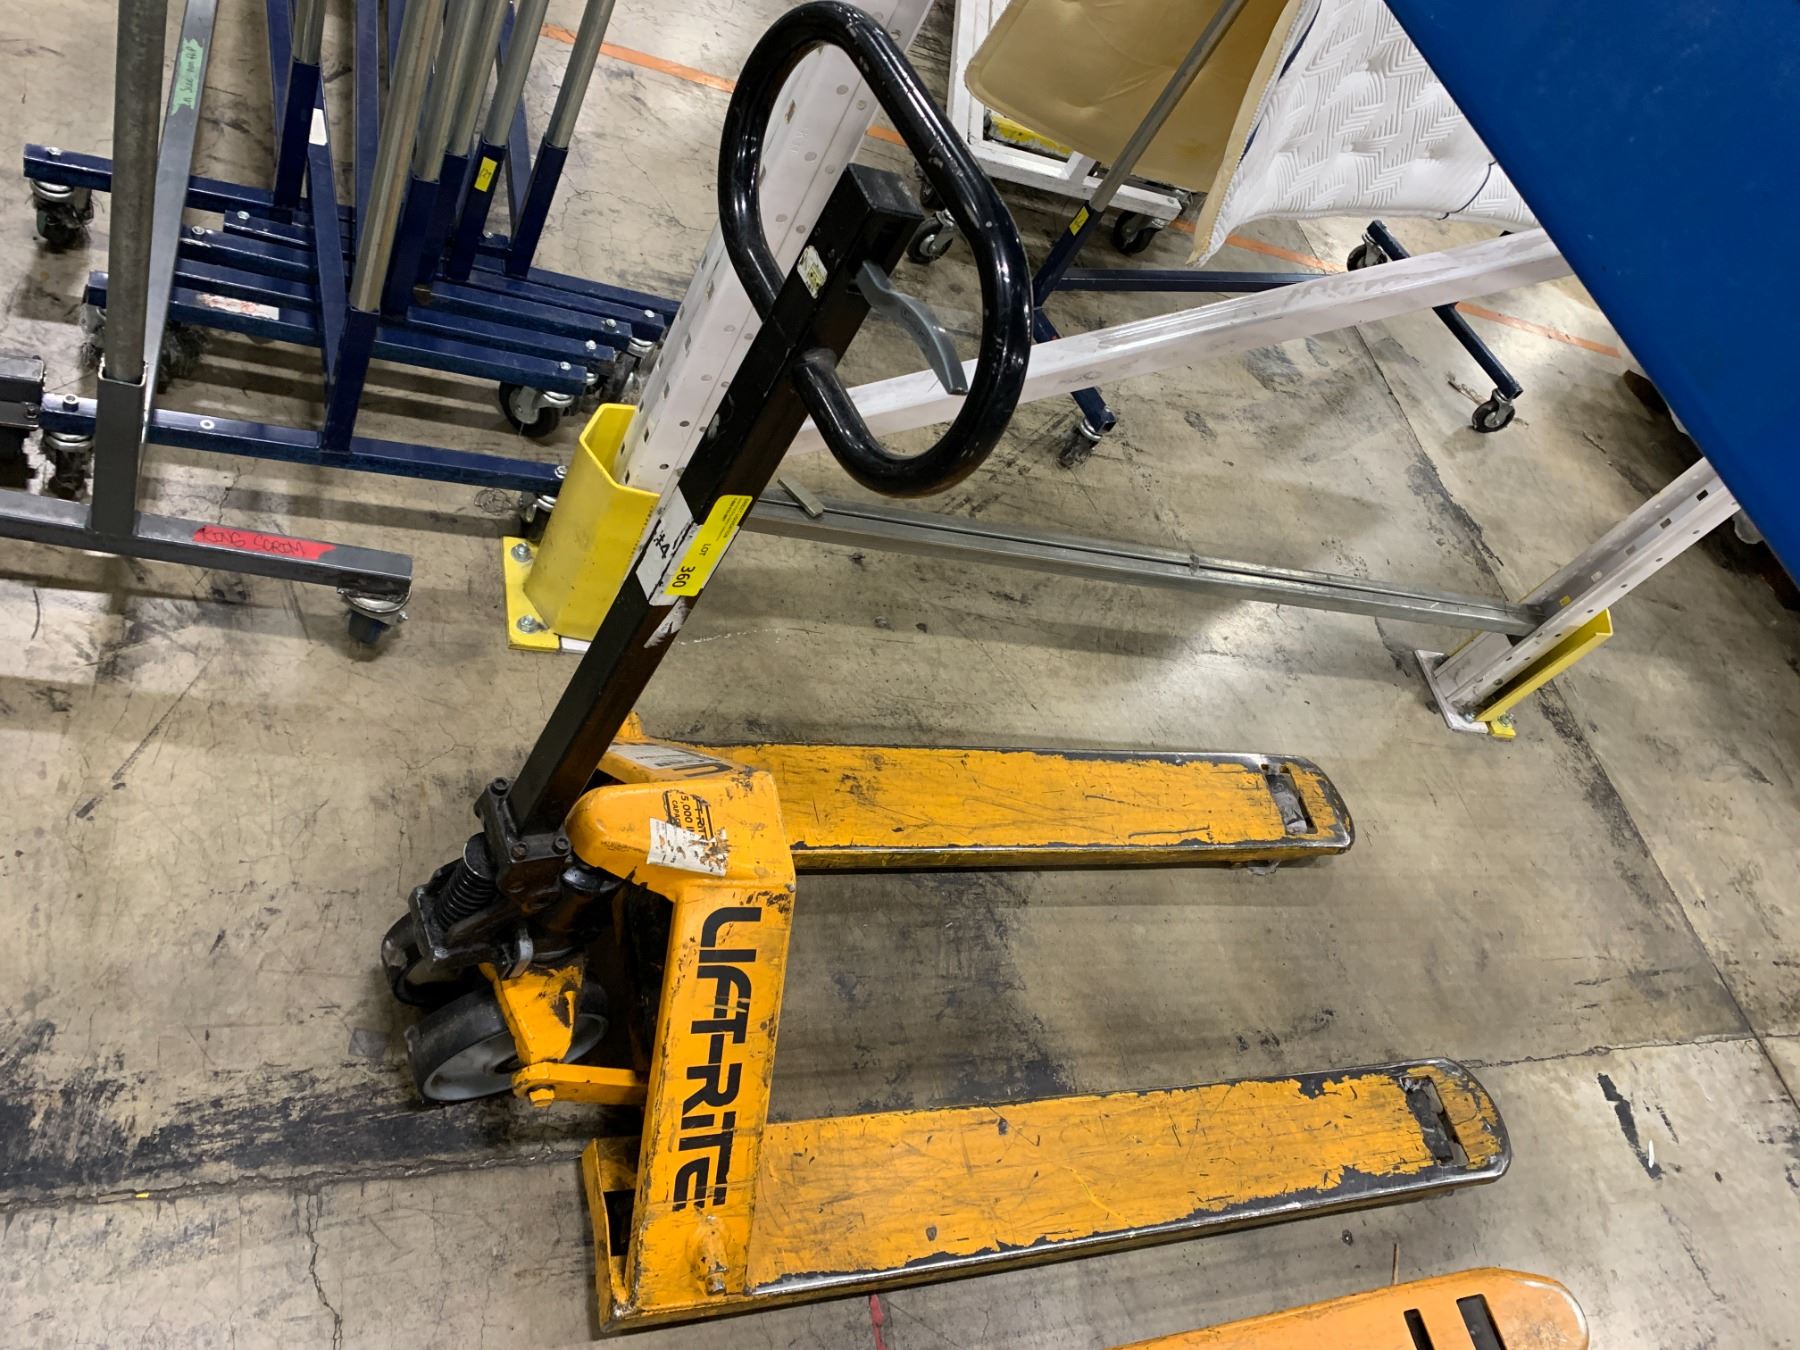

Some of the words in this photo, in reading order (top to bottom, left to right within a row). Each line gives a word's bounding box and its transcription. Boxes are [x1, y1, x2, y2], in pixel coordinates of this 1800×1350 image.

[699, 543, 712, 556] LOT
[672, 566, 696, 588] 360
[681, 795, 693, 823] 5,000
[672, 907, 762, 1212] LIFT-RITE
